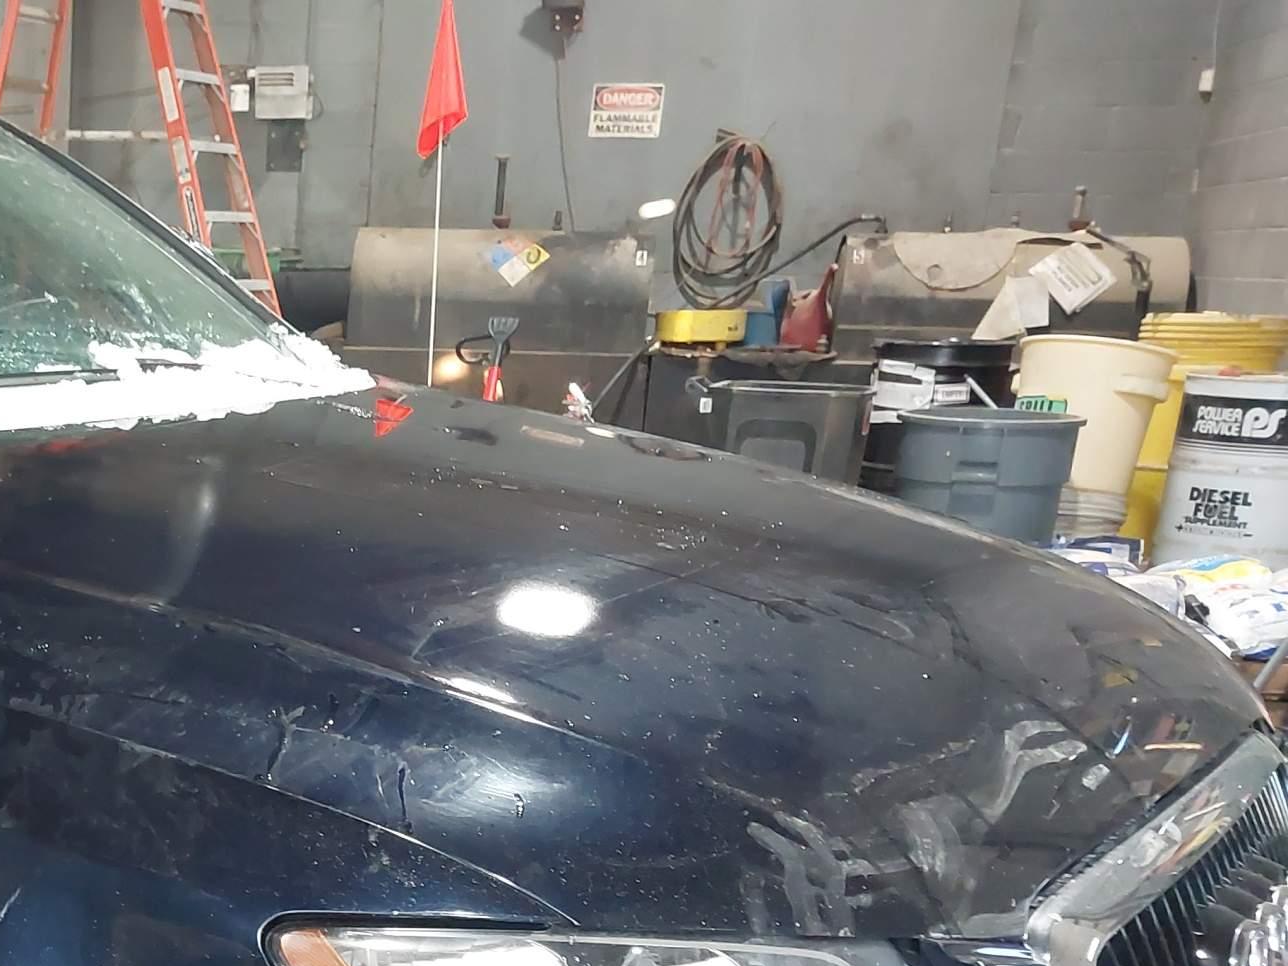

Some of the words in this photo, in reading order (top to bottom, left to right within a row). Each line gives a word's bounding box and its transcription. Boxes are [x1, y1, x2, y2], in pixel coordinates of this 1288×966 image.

[602, 92, 655, 106] DANGER
[593, 113, 658, 123] FLAMMABLE
[595, 124, 654, 133] MATERIALS
[1196, 405, 1243, 422] POWER
[1192, 420, 1241, 436] SERVICE
[1189, 486, 1253, 507] DIESEL
[1193, 502, 1239, 520] FUEL
[1183, 516, 1248, 529] SUPPLEMENT
